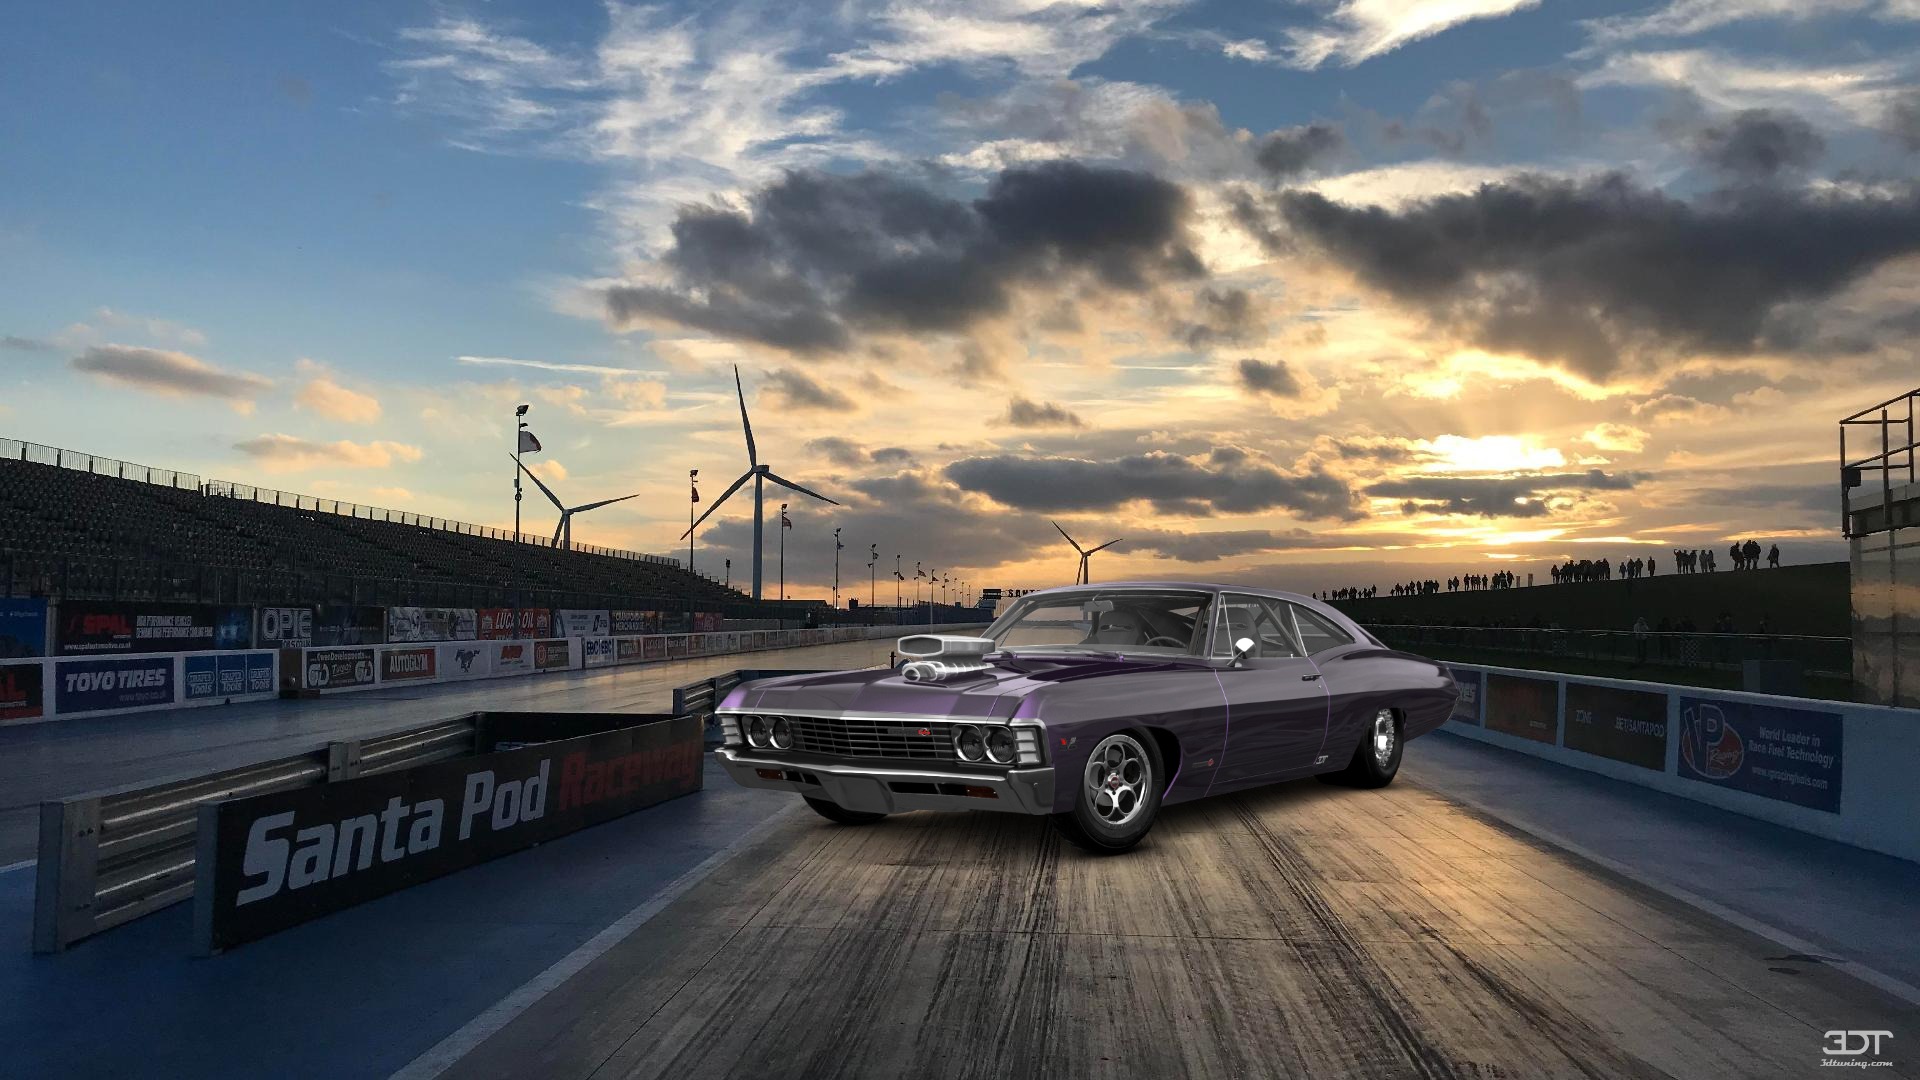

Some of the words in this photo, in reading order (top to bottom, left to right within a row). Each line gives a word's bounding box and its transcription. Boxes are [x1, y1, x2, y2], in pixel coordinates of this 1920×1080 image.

[262, 608, 312, 638] OPIE
[390, 654, 428, 673] AUTOGLYM
[65, 671, 116, 693] TOYO
[117, 668, 167, 689] TIRES
[191, 683, 213, 696] TOOLS
[222, 681, 243, 693] TOOLS
[251, 679, 271, 690] TOOLS
[1782, 729, 1810, 745] Leader
[1786, 745, 1834, 769] Technology
[236, 795, 445, 907] Santa
[459, 759, 551, 841] Pod
[560, 742, 697, 811] Raceway
